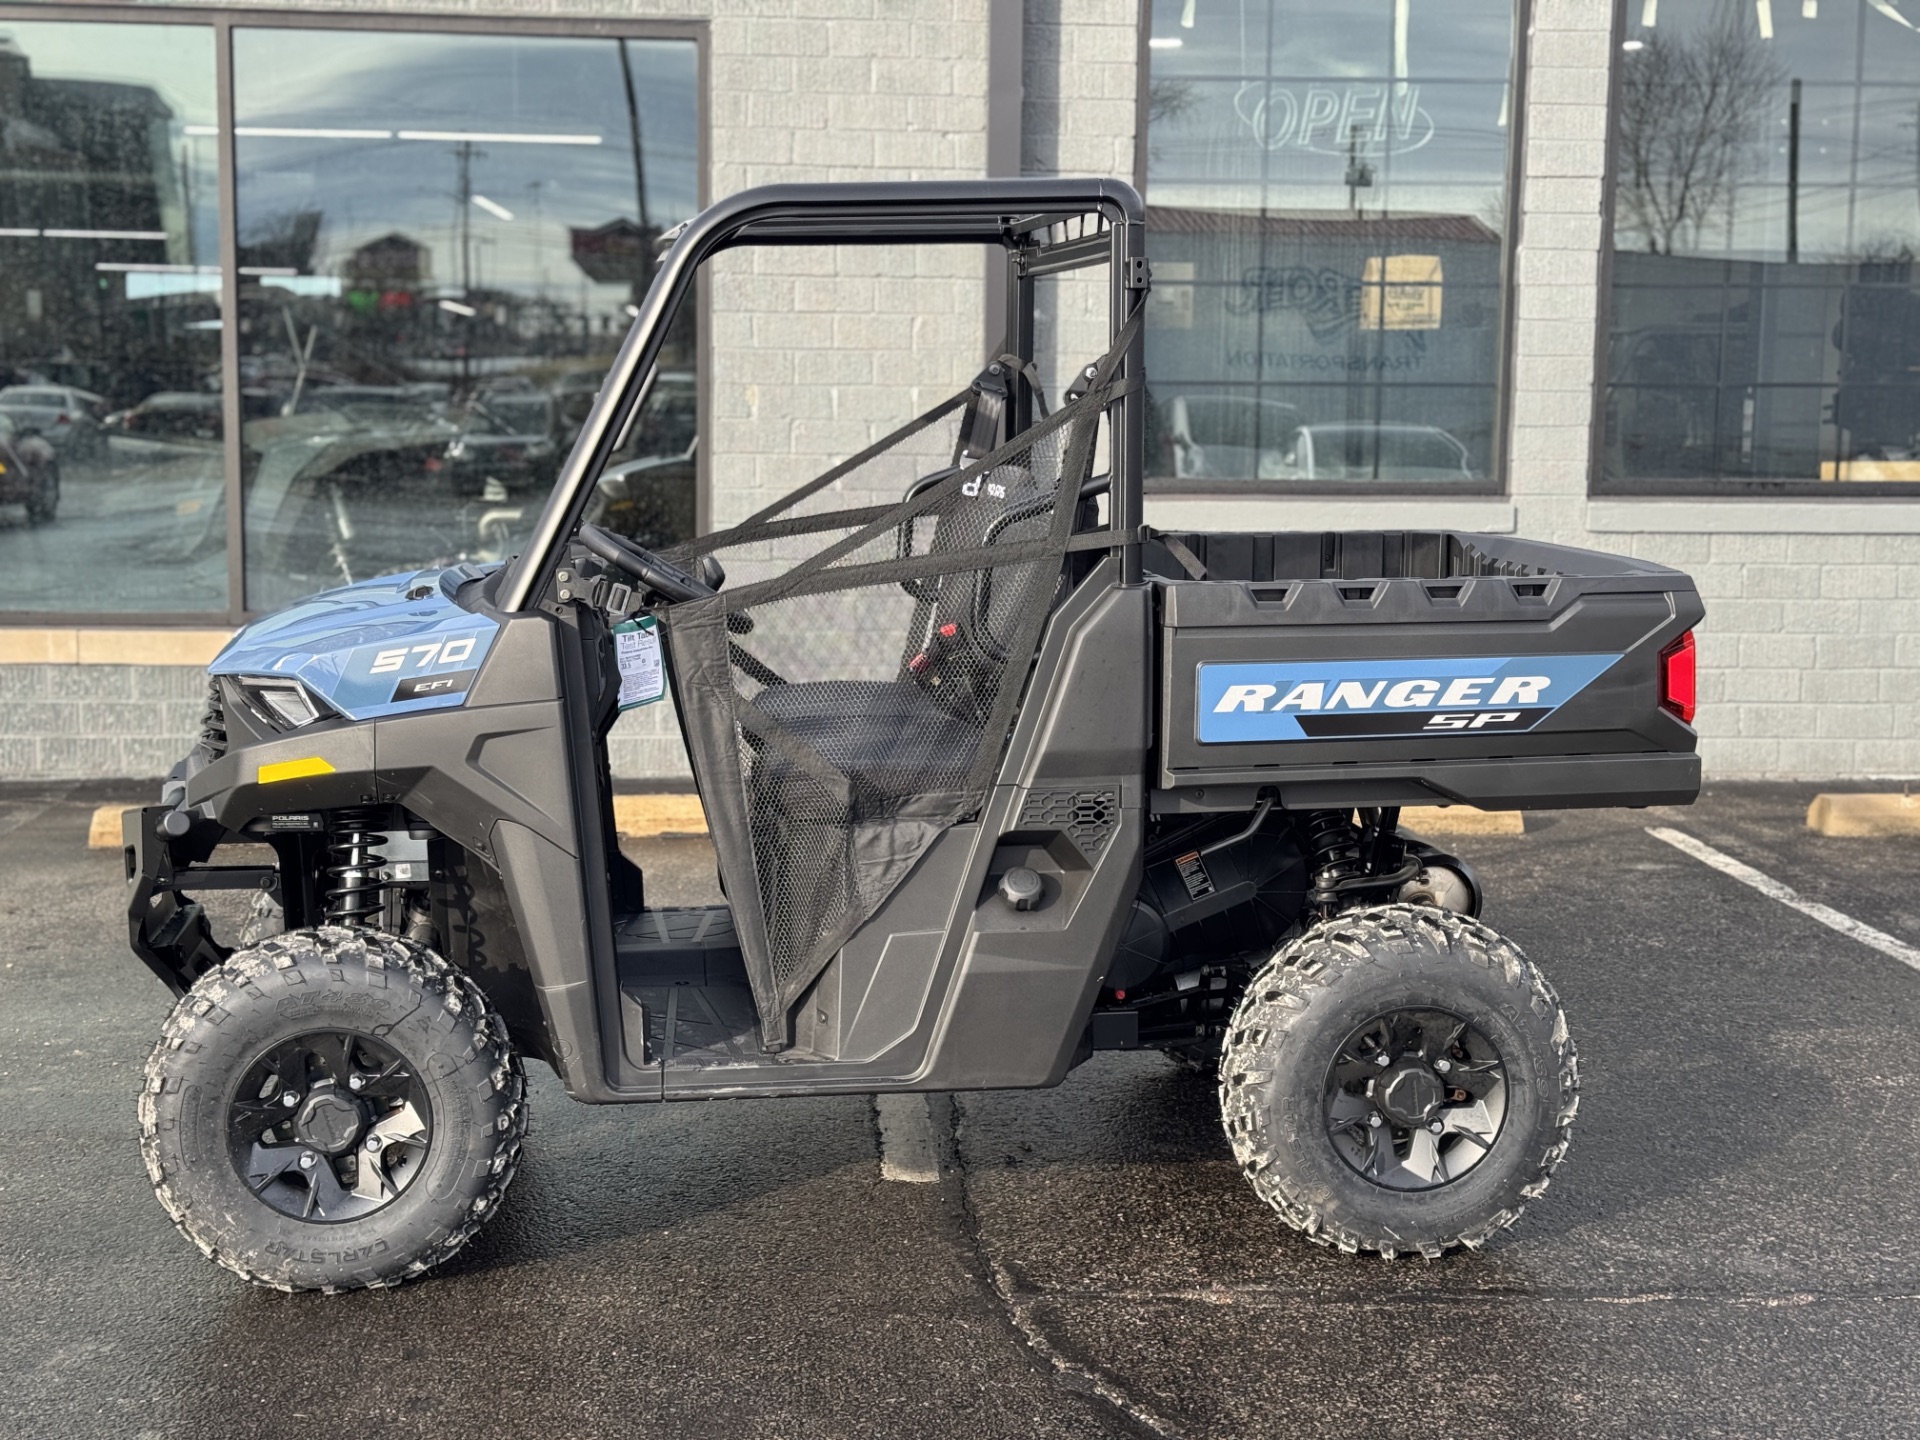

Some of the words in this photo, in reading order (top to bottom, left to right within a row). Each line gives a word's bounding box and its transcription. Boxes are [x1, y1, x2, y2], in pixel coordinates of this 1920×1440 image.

[1253, 86, 1420, 150] OPEN
[620, 642, 636, 650] Test
[621, 634, 635, 643] Tilt
[369, 637, 477, 674] 570
[413, 679, 454, 693] EFI
[1213, 676, 1551, 713] RANGER
[1423, 712, 1521, 730] SP
[264, 1237, 390, 1264] CARLSTAR
